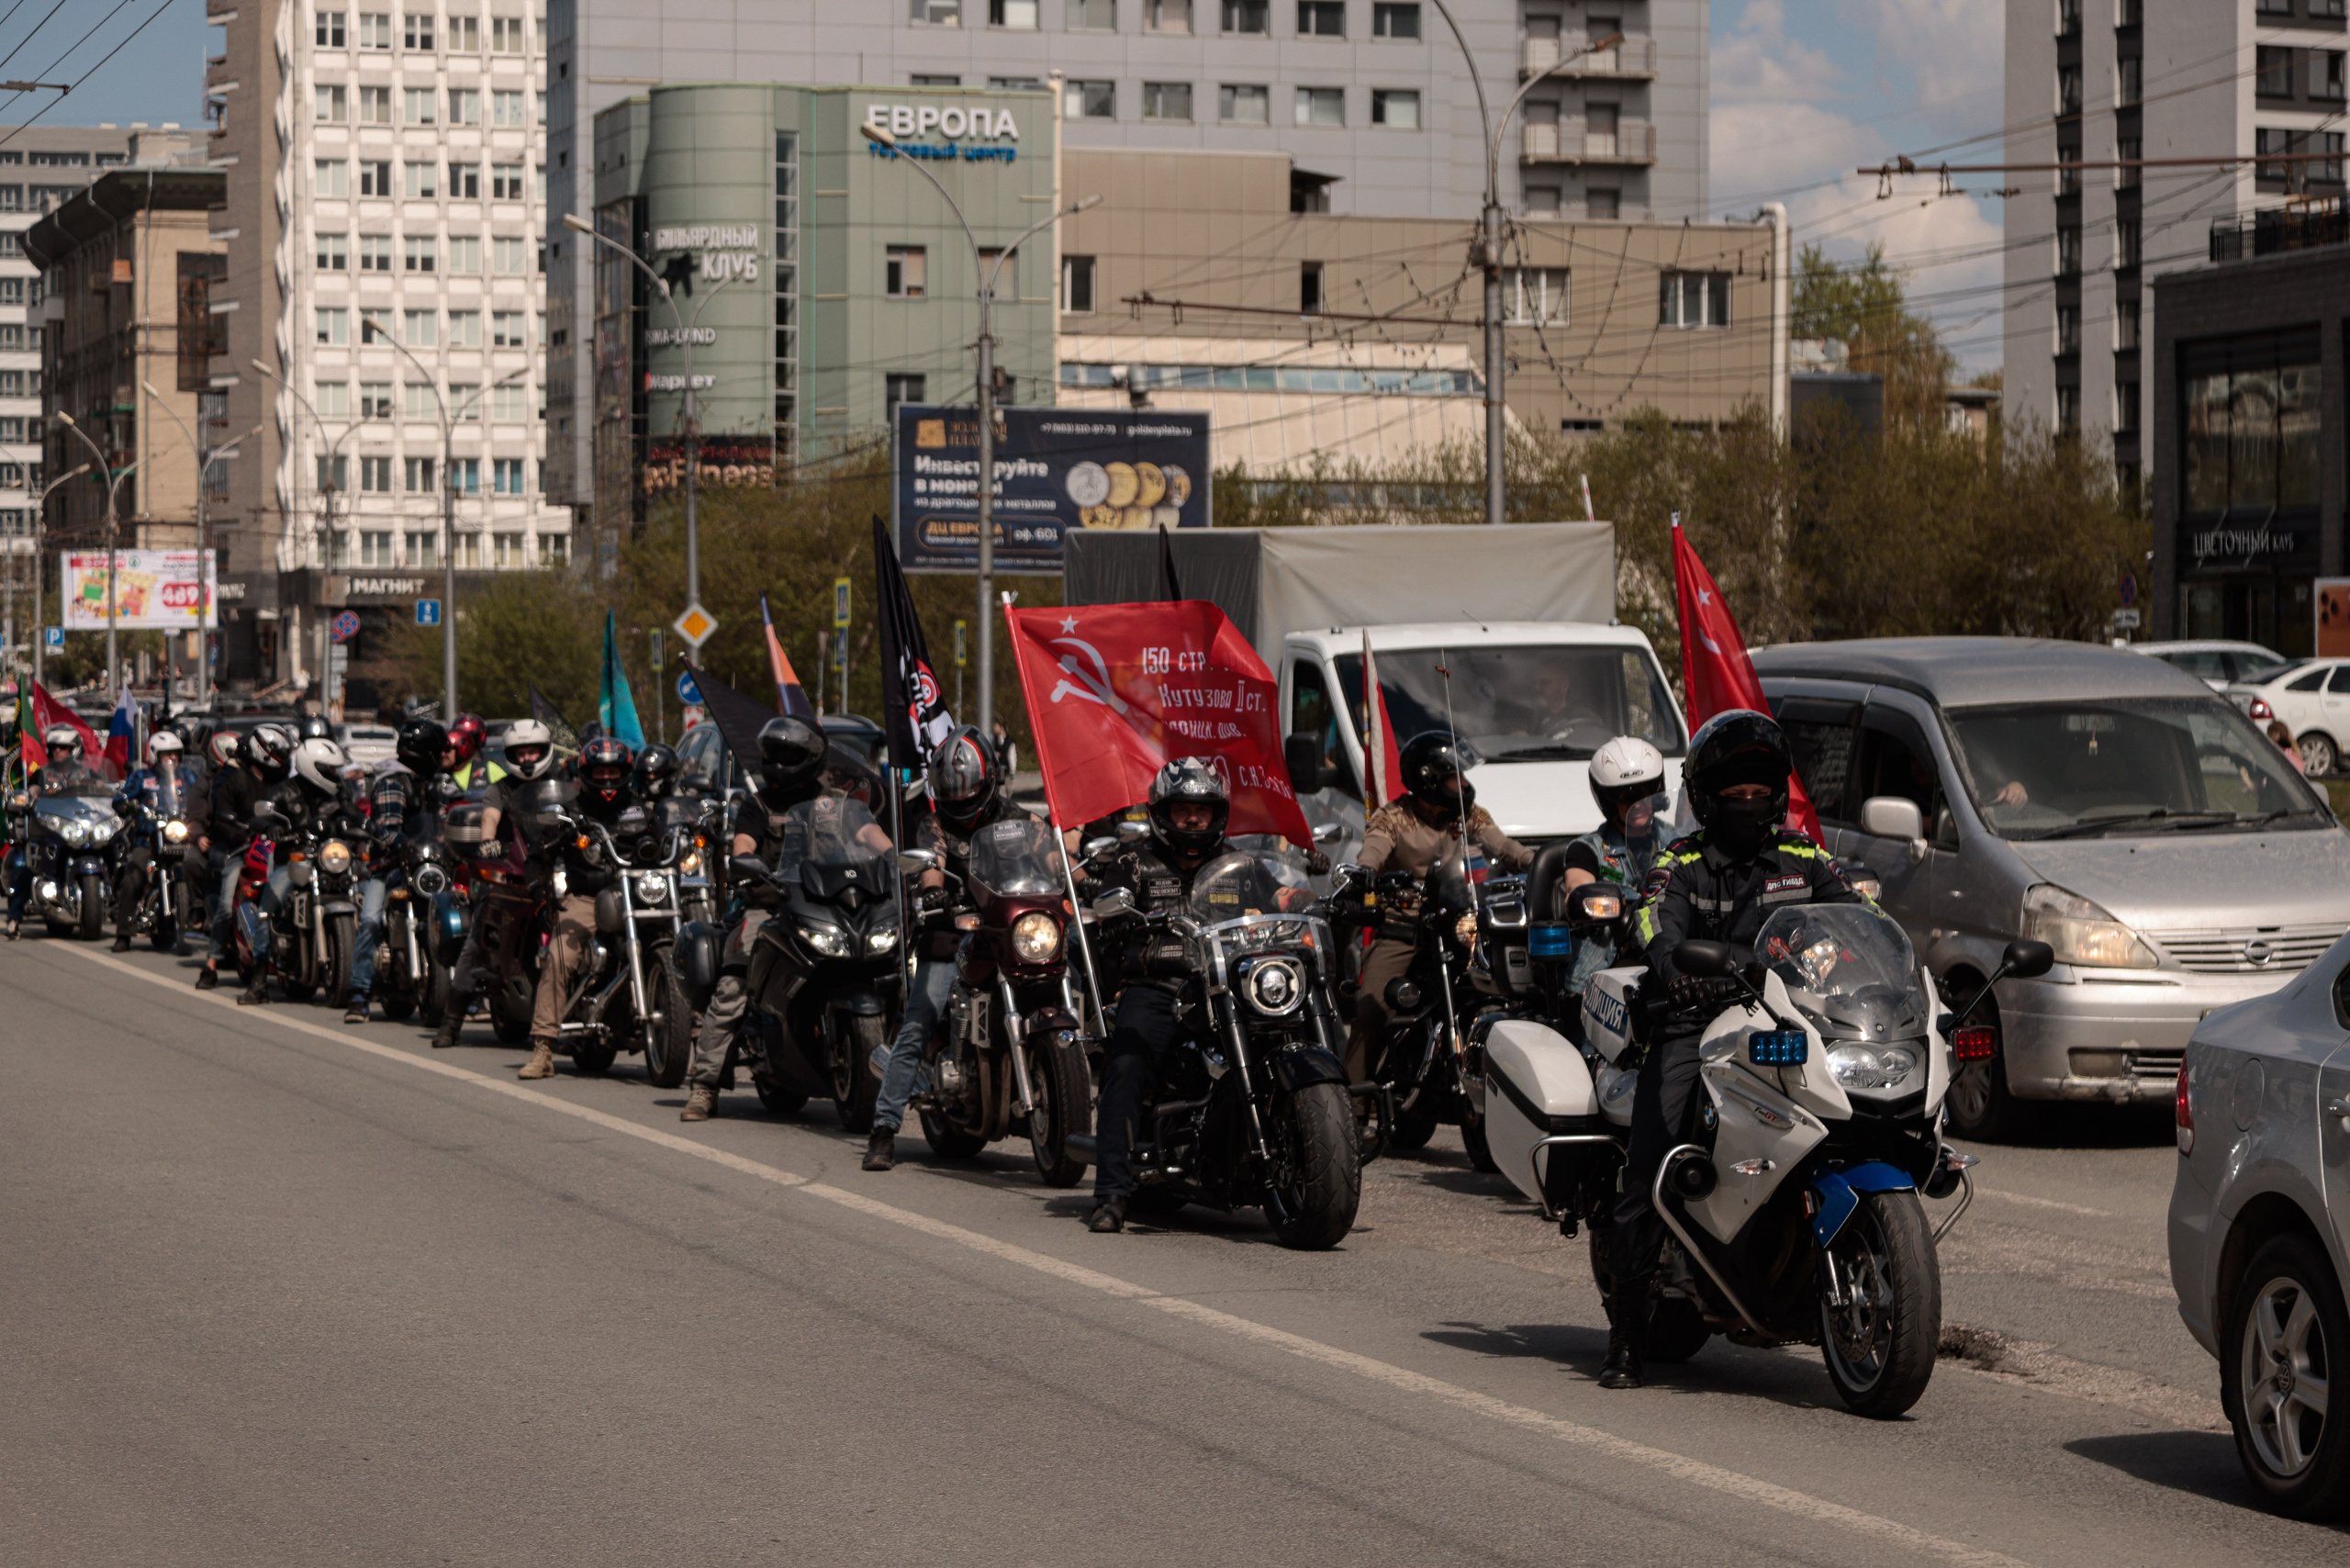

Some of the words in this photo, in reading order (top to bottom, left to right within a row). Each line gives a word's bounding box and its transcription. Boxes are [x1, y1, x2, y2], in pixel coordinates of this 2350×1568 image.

[867, 105, 1019, 139] ЕВРОПА
[965, 146, 1016, 163] центр
[655, 224, 758, 250] БИЛЬЯРДНЫЙ
[703, 253, 758, 280] КЛУБ
[914, 455, 1049, 480] Инвеструйте
[929, 479, 1003, 495] монеы
[930, 498, 1003, 510] драгоценх
[950, 522, 1003, 535] ЕВРОА
[2194, 528, 2269, 556] ЦВЕТОЧНЫЙ
[352, 577, 425, 595] МАГНИТ
[50, 628, 61, 644] P
[1142, 645, 1169, 675] 150
[1586, 981, 1625, 1030] ОЛИЦИЯ
